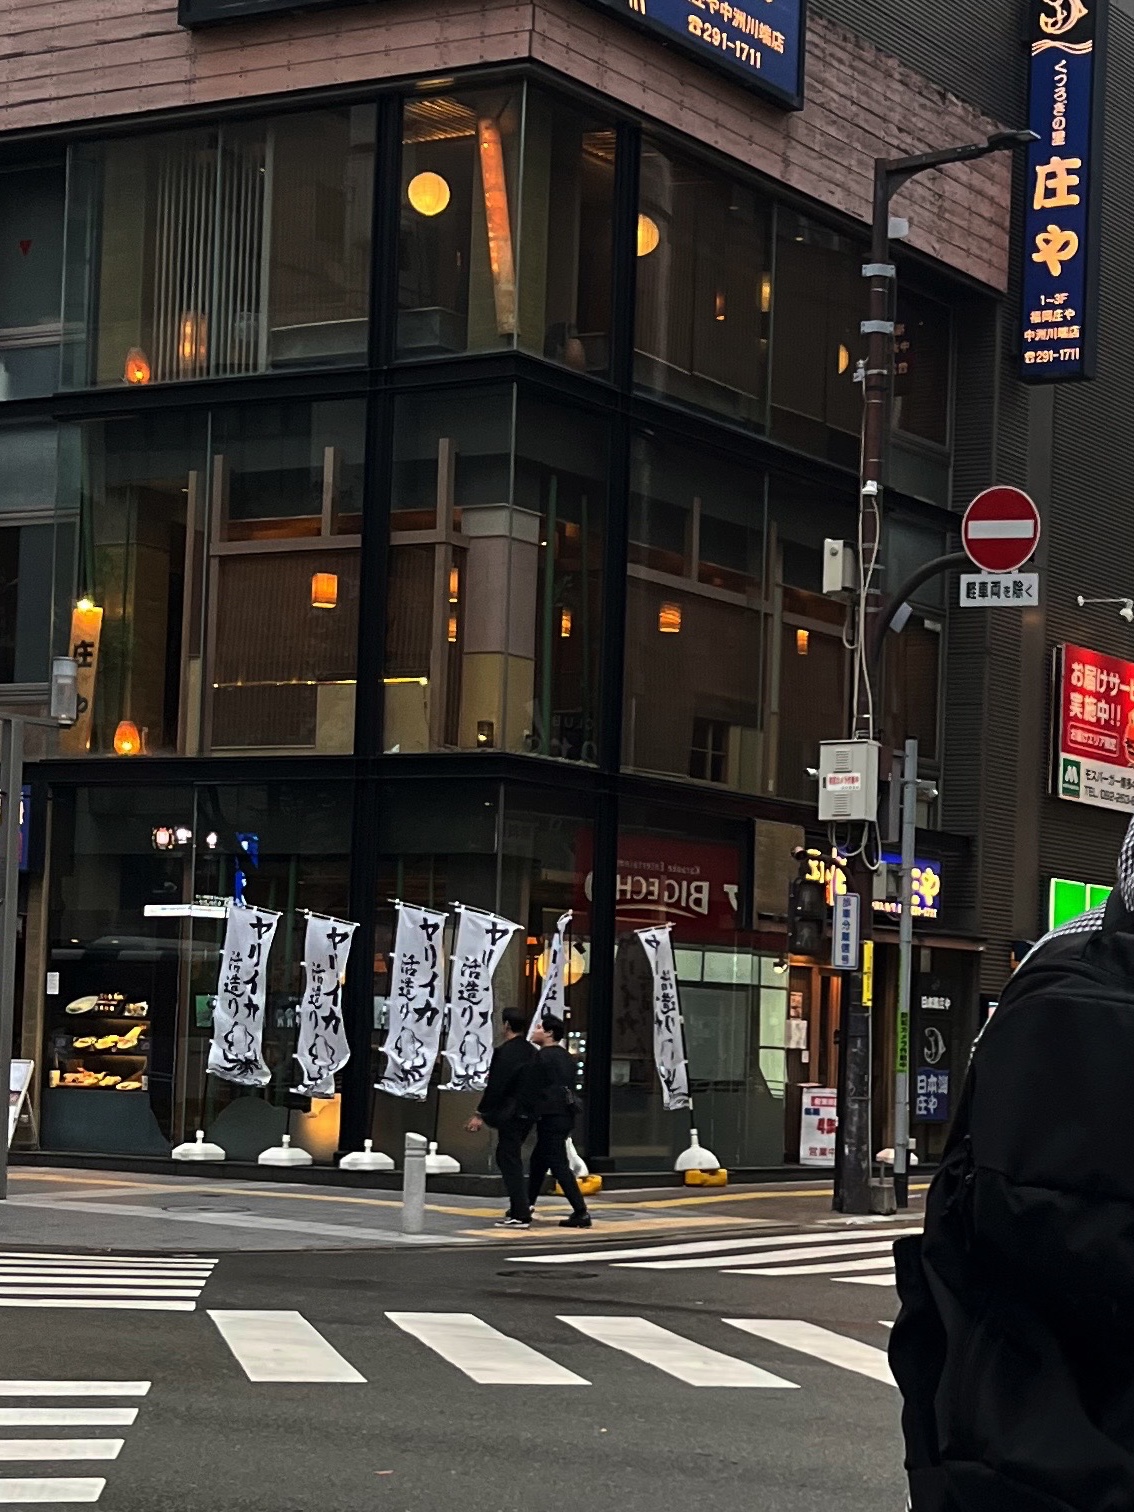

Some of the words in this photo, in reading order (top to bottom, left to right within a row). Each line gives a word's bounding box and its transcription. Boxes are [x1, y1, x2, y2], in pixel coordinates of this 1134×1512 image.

[703, 22, 762, 69] 291-1711
[1031, 156, 1082, 277] 庄や
[1035, 347, 1080, 363] 291-1711
[243, 915, 274, 1022] ヤリイカ
[413, 916, 441, 1027] ヤリイカ
[457, 955, 484, 1028] 活造り
[916, 1095, 938, 1115] 庄や
